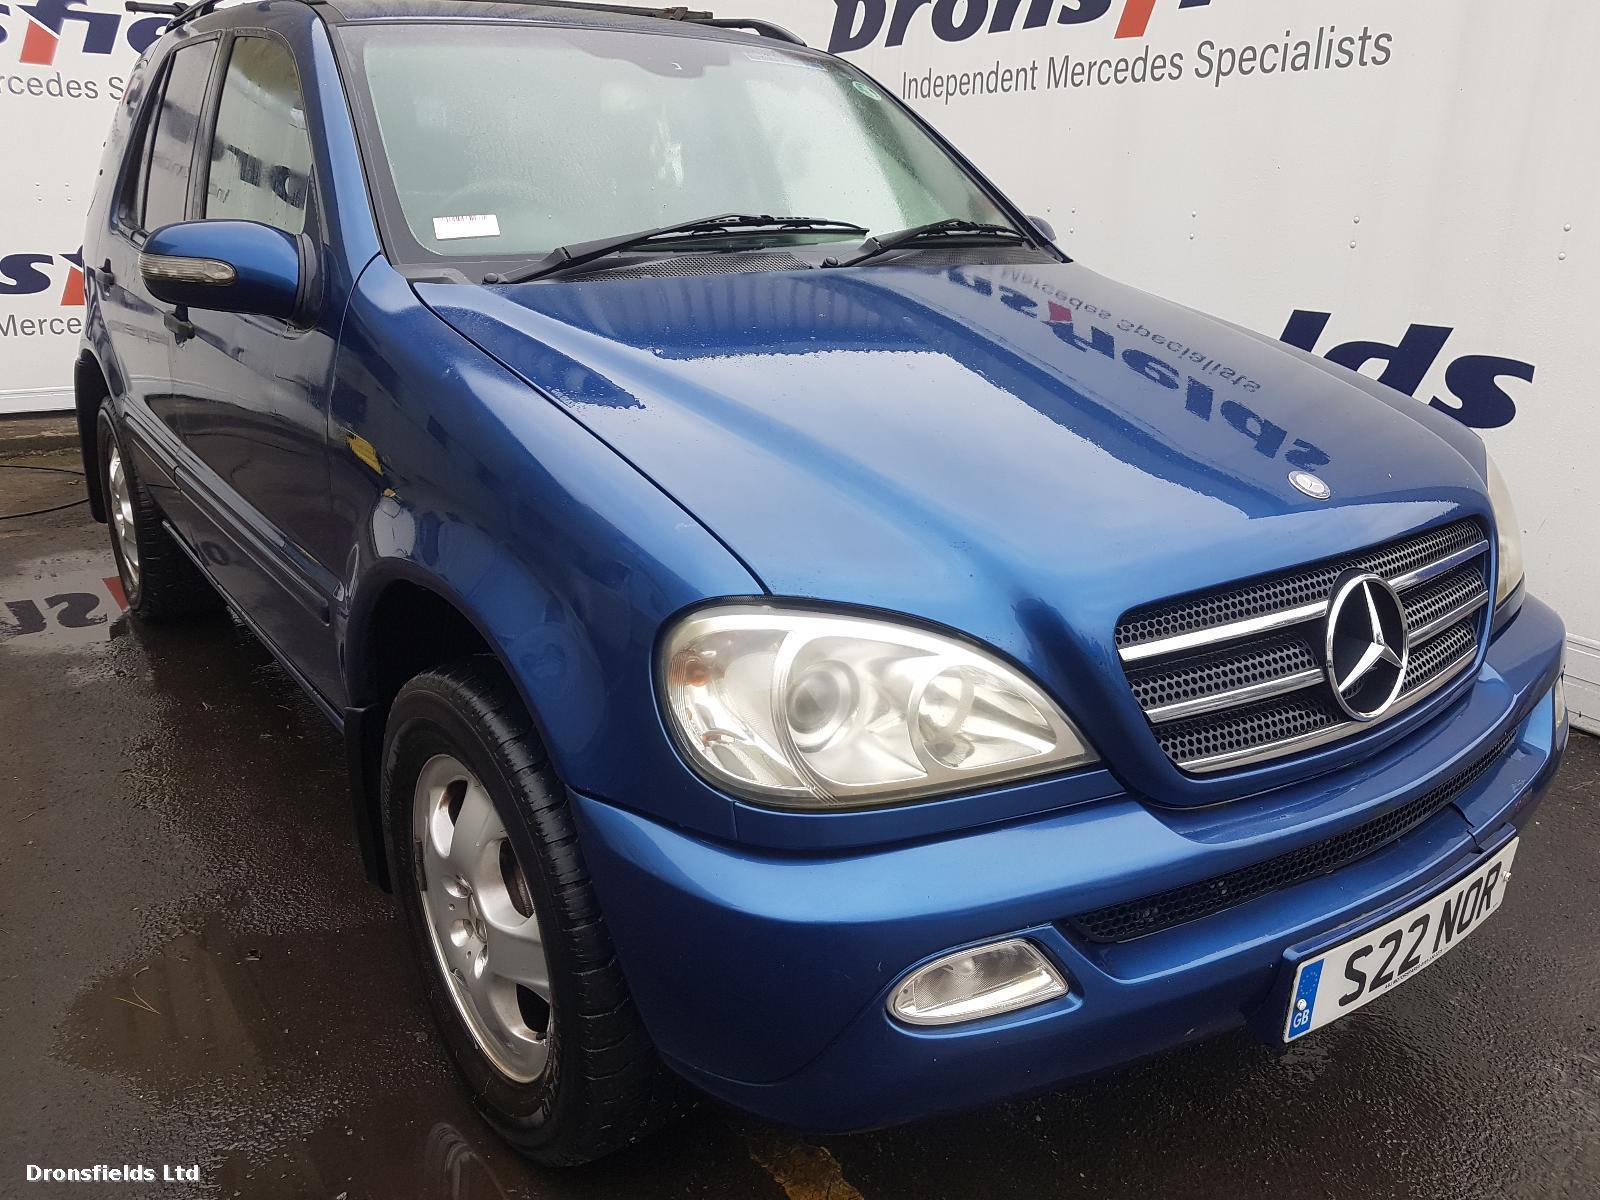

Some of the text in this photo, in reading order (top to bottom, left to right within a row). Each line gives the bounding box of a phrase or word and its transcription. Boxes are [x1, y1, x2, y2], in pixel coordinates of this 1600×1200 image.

[902, 25, 1392, 104] Independent Mercedes Specialists
[1338, 913, 1431, 1007] S22
[1432, 860, 1502, 954] NOR
[1292, 1009, 1309, 1028] GB
